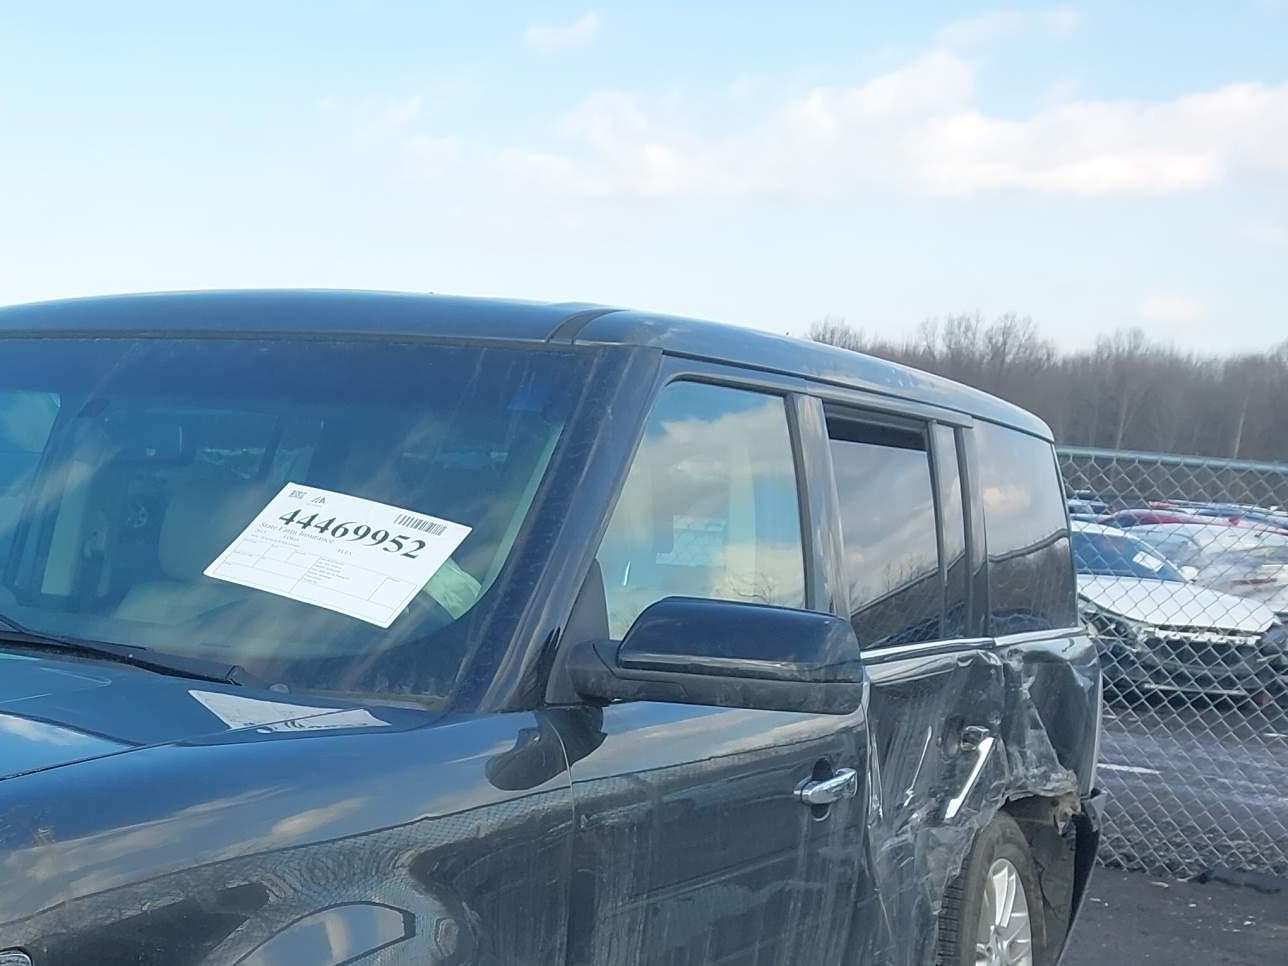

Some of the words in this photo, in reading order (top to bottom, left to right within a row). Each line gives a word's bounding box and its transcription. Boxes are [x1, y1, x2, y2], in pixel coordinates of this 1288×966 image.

[260, 522, 278, 530] State
[279, 526, 298, 536] Farm
[299, 530, 336, 544] Insurance
[279, 508, 426, 559] 44469952
